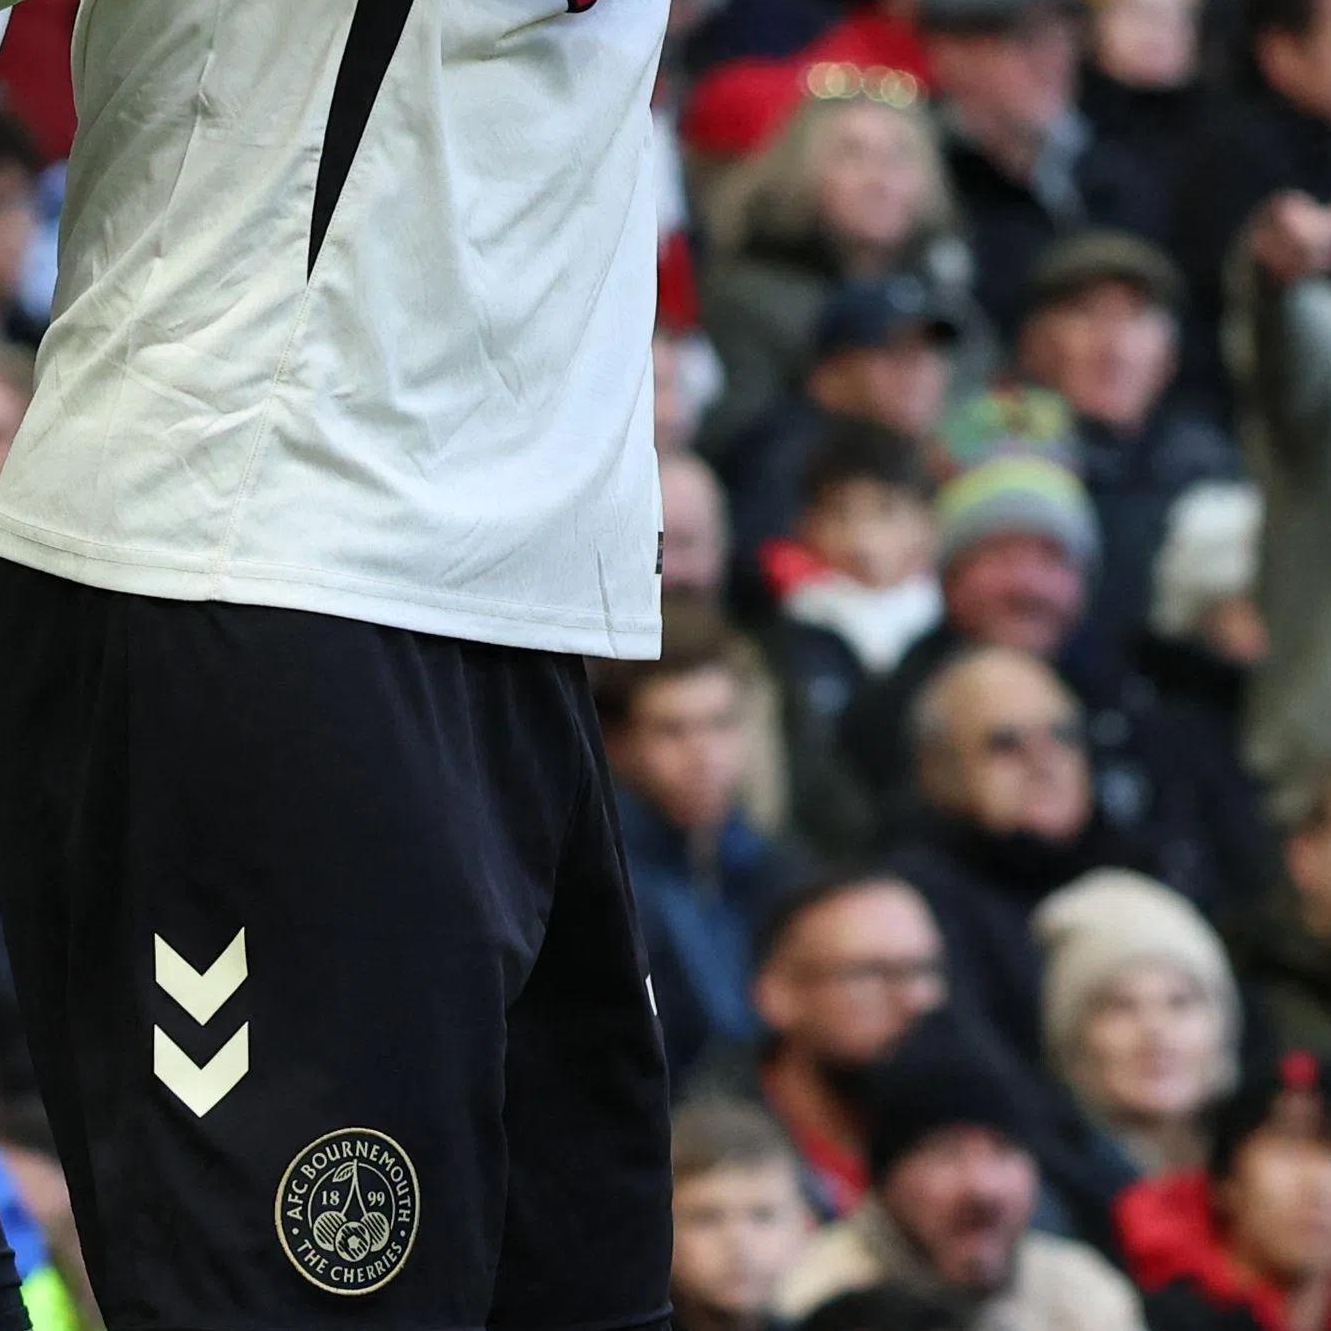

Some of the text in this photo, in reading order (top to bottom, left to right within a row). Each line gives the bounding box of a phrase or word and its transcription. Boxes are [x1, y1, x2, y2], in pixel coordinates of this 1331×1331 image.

[286, 1140, 411, 1223] AFC BOURNEMOUTH
[321, 1190, 386, 1207] 18 99
[296, 1239, 402, 1283] THE CHERRIES
